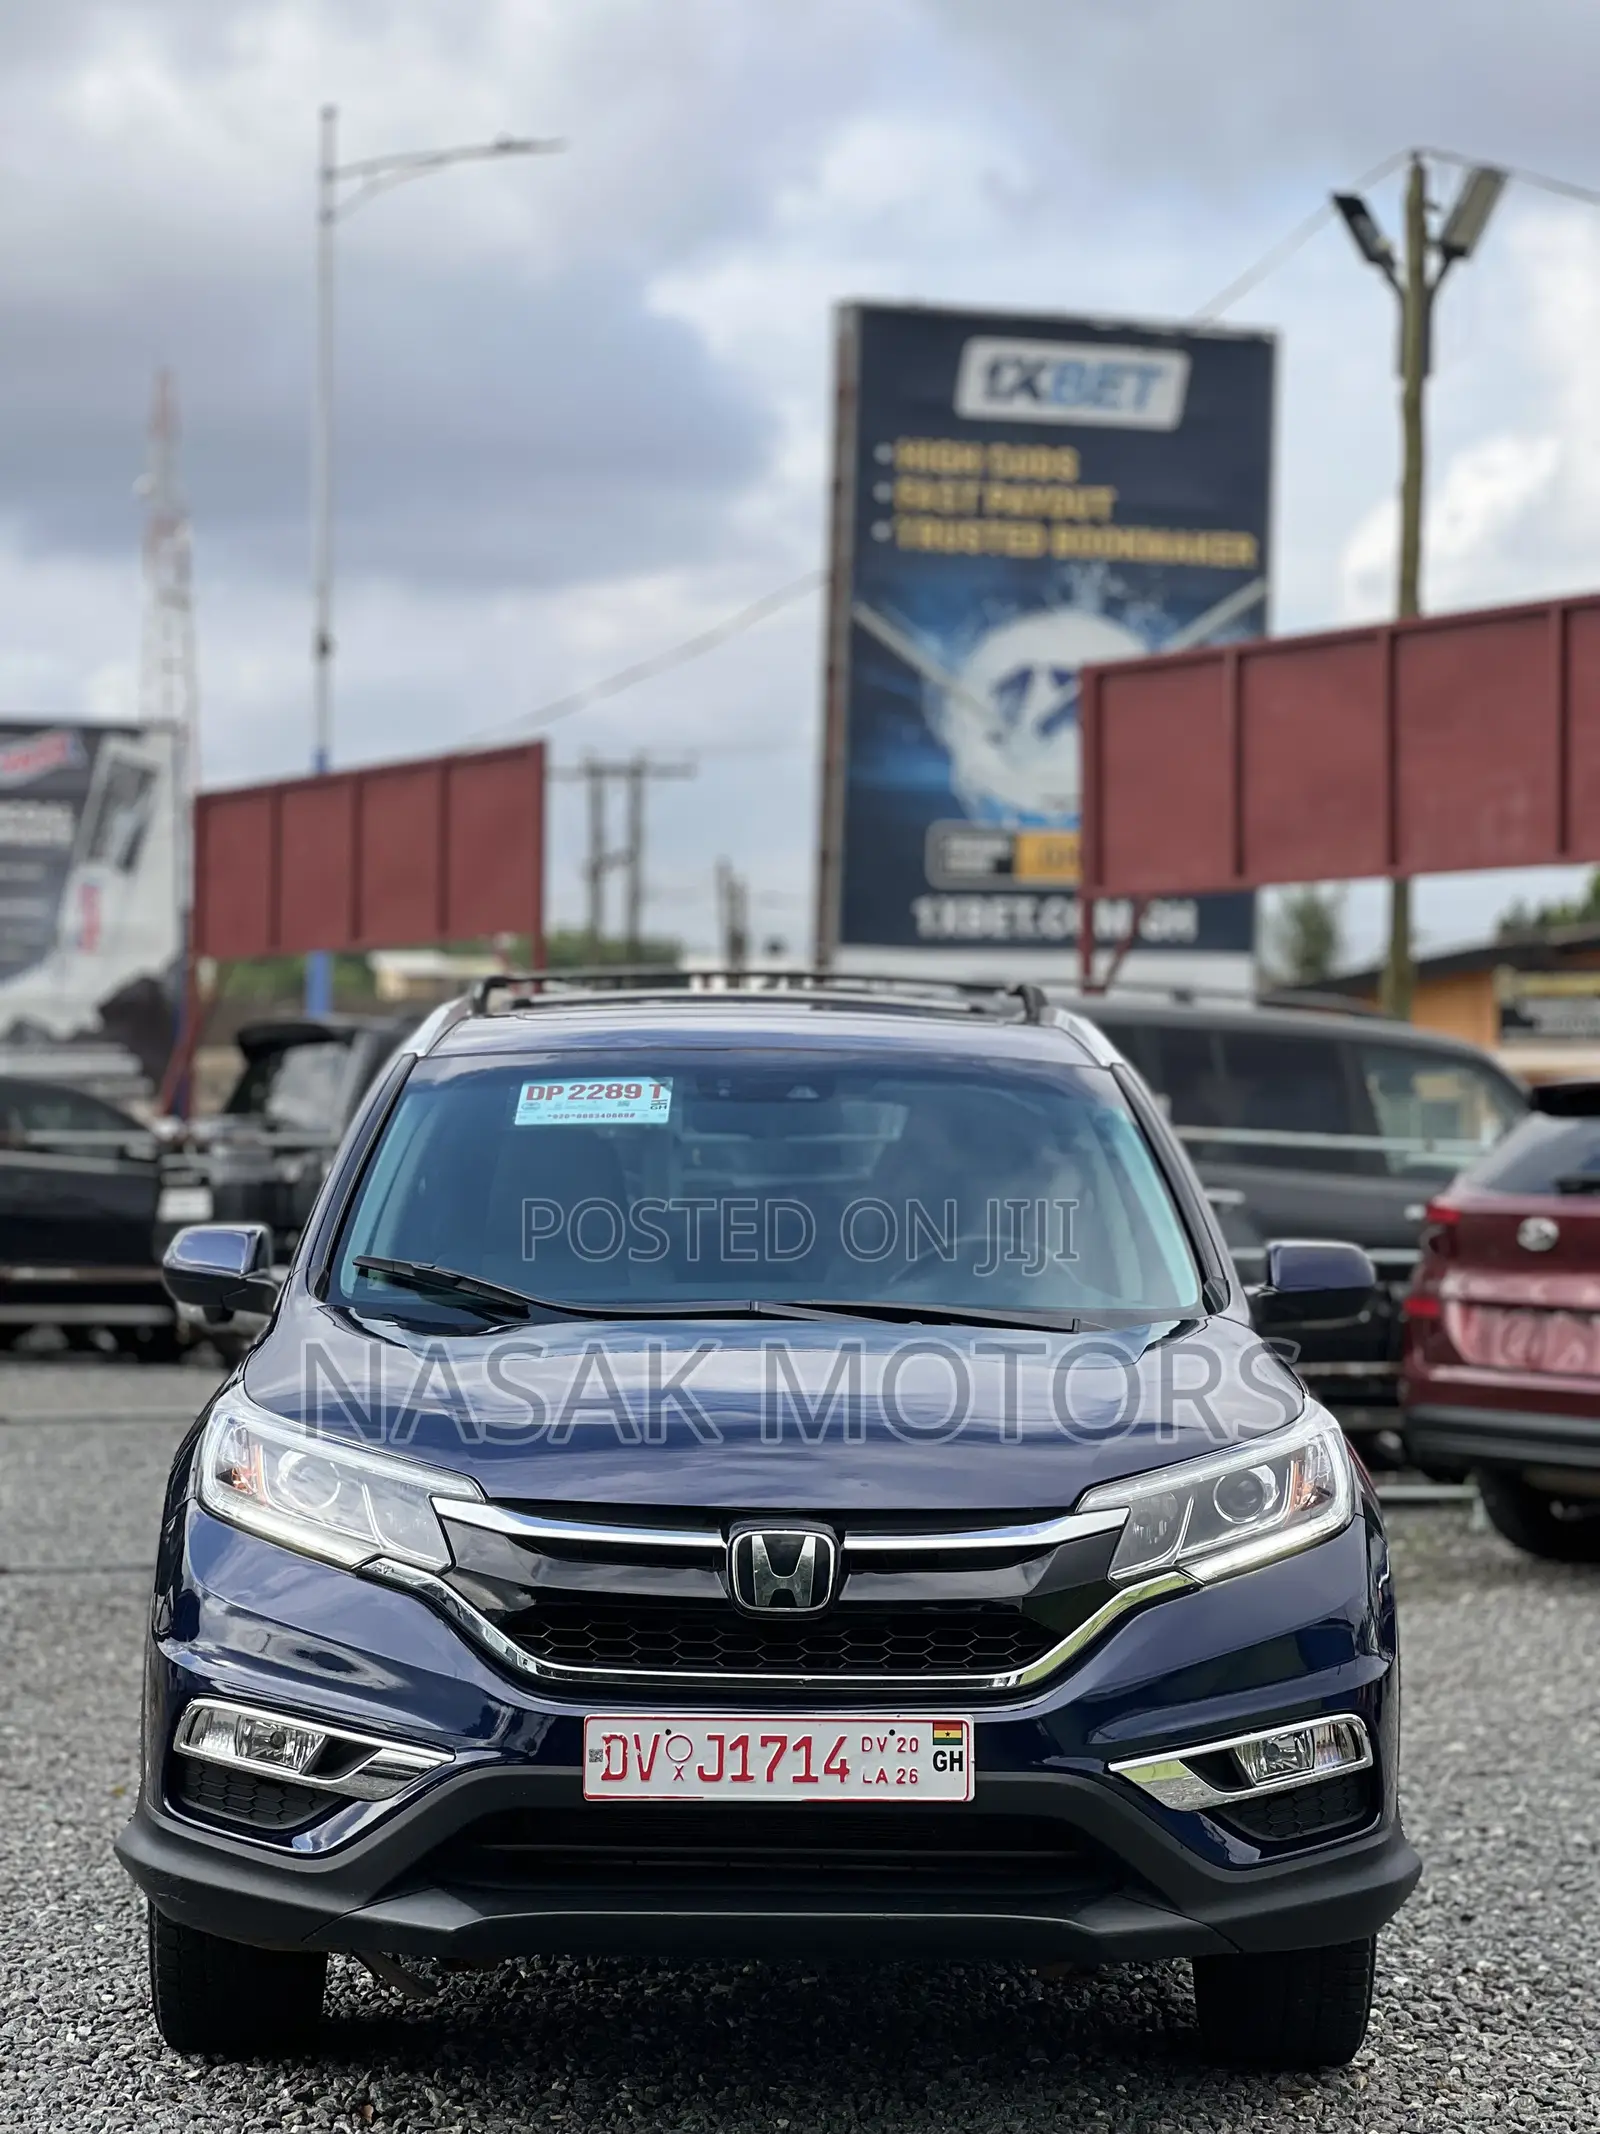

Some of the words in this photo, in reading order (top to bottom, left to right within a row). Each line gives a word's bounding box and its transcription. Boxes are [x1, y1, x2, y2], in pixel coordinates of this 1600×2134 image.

[897, 515, 1047, 559] TRUSTED
[526, 1085, 564, 1101] DP
[568, 1083, 642, 1100] 2289
[649, 1083, 665, 1099] T
[861, 1736, 888, 1753] DV
[896, 1736, 919, 1753] 20
[601, 1732, 661, 1782] DV
[696, 1732, 850, 1783] J1714
[932, 1750, 964, 1772] GH
[862, 1768, 889, 1785] LA
[896, 1768, 919, 1785] 26
